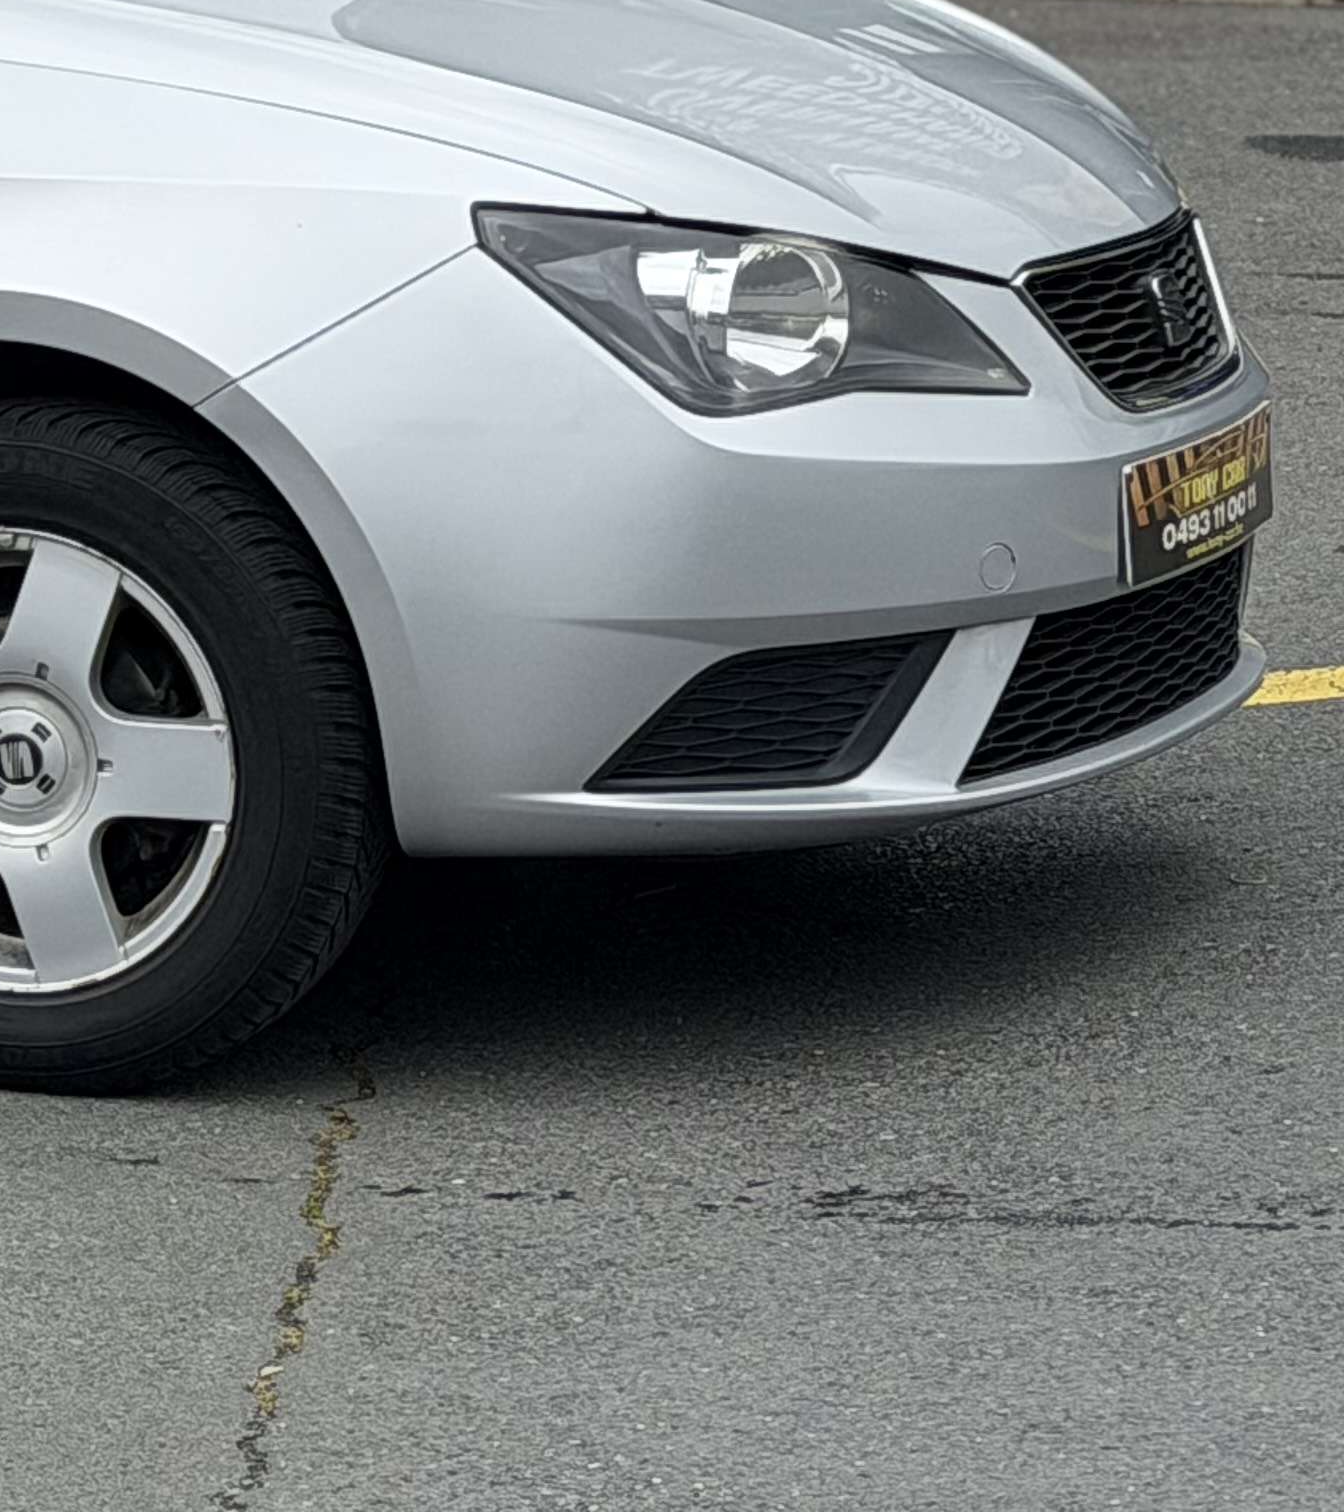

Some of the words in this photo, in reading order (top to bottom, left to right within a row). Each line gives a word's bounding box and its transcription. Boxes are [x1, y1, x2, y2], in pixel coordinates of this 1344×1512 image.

[1181, 469, 1219, 507] TONY
[1162, 509, 1211, 551] 0493
[1213, 501, 1226, 530] 11
[1227, 492, 1246, 522] 00
[1247, 482, 1258, 510] 11
